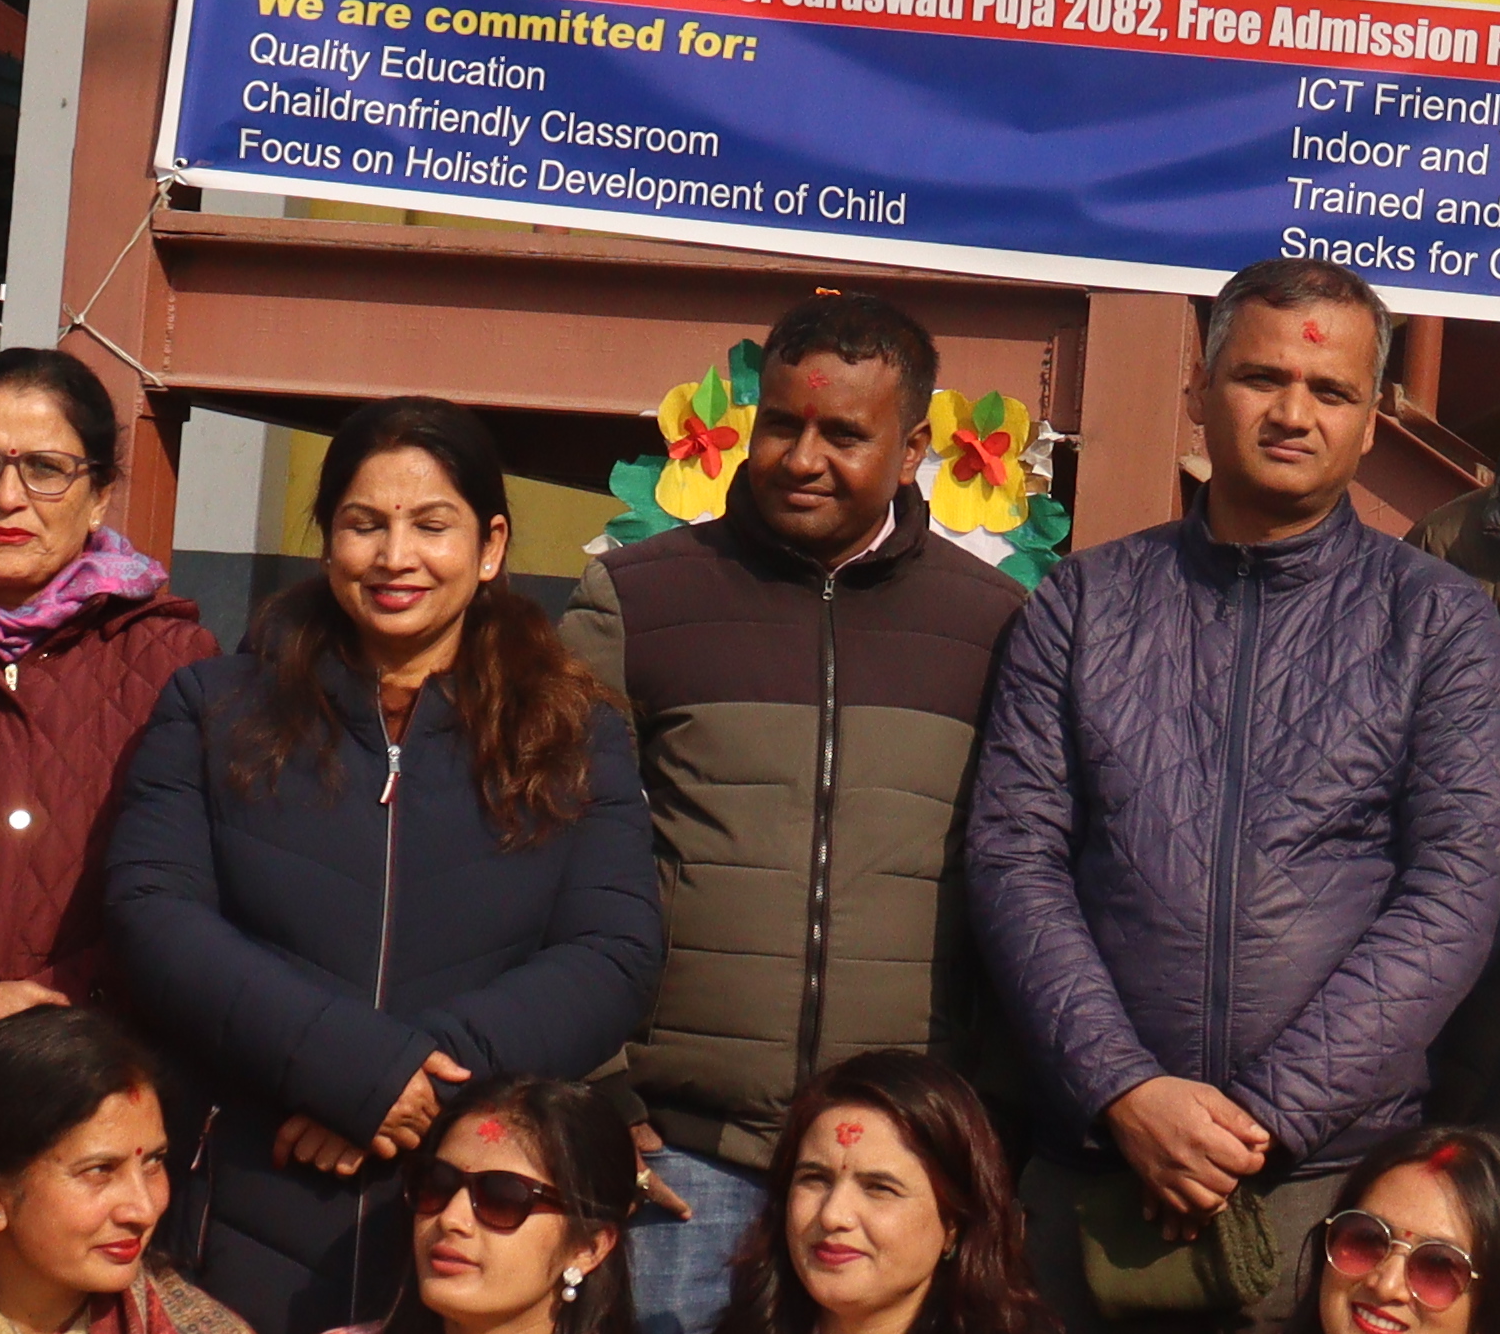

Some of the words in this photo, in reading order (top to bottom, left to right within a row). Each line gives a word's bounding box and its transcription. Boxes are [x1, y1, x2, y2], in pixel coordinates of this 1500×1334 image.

[337, 0, 412, 30] are
[425, 7, 665, 52] committed
[679, 22, 757, 61] for:
[1268, 6, 1479, 64] Admission
[249, 32, 371, 81] Quality
[380, 45, 545, 91] Education
[242, 80, 531, 147] Chaildrenfriendly
[540, 110, 719, 157] Classroom
[1297, 76, 1365, 113] ICT
[239, 128, 341, 169] Focus
[352, 148, 394, 175] on
[404, 146, 528, 188] Holistic
[537, 159, 764, 212] Development
[774, 183, 810, 215] of
[818, 186, 906, 225] Child
[1292, 126, 1411, 168] Indoor
[1420, 143, 1490, 176] and
[1287, 176, 1425, 220] Trained
[1280, 226, 1415, 271] Snacks
[1428, 240, 1479, 276] for
